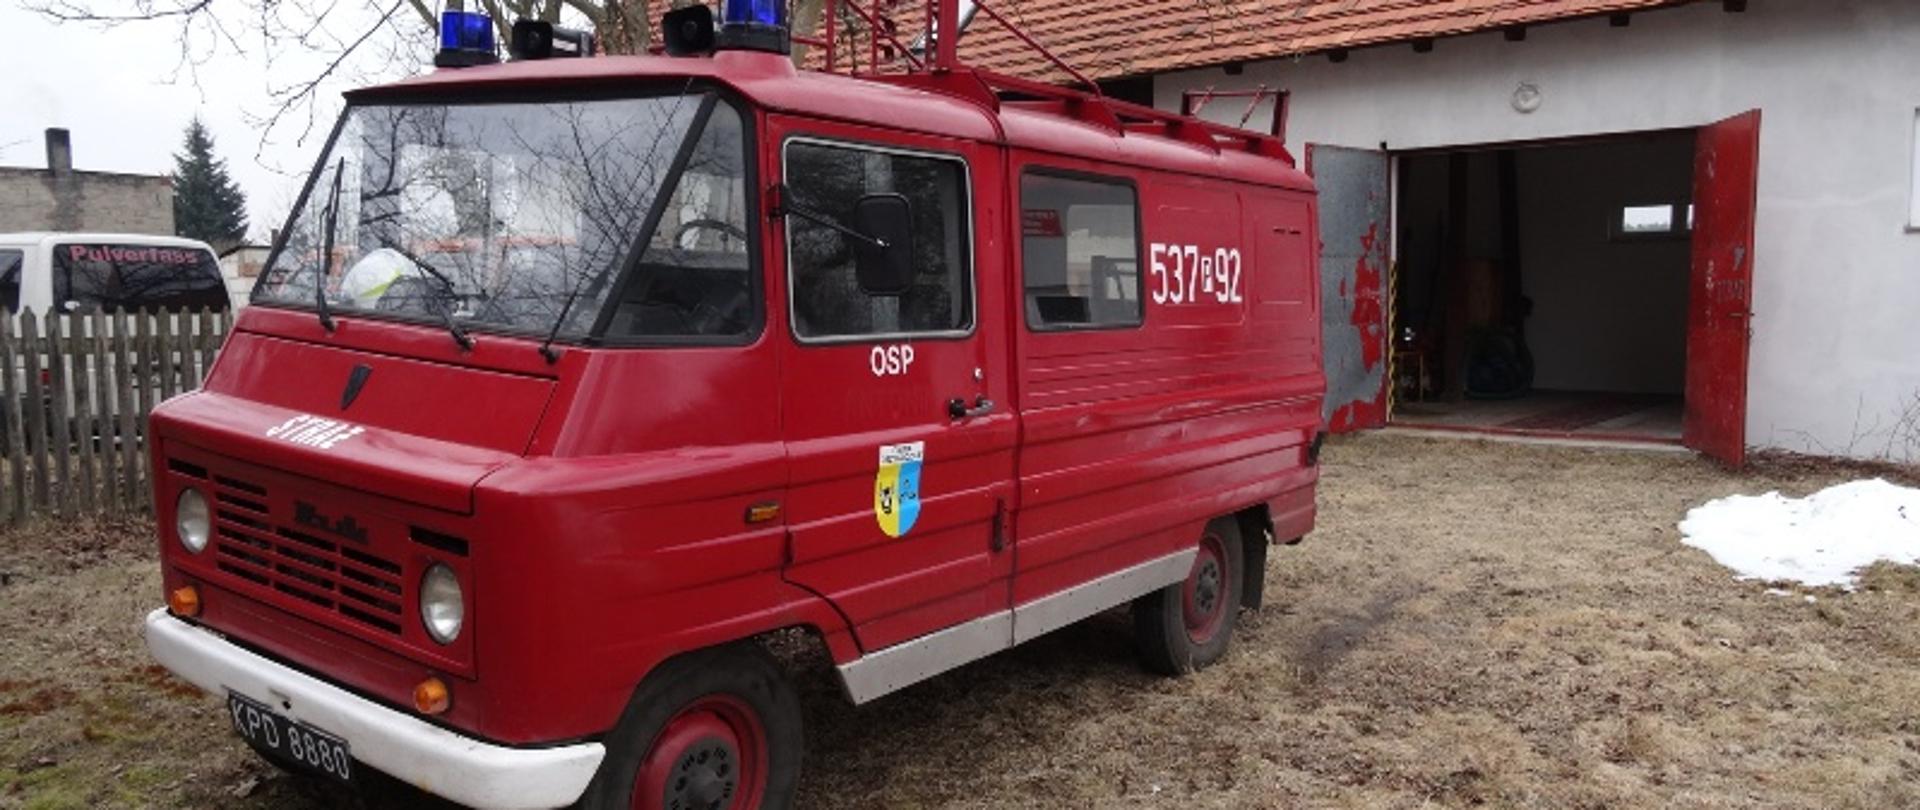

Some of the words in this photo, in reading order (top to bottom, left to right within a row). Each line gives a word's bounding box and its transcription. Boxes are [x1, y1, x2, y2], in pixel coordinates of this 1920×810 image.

[69, 245, 198, 264] Pulverfass
[871, 344, 914, 376] OSP
[231, 699, 280, 748] KPD
[287, 726, 350, 780] 8880
